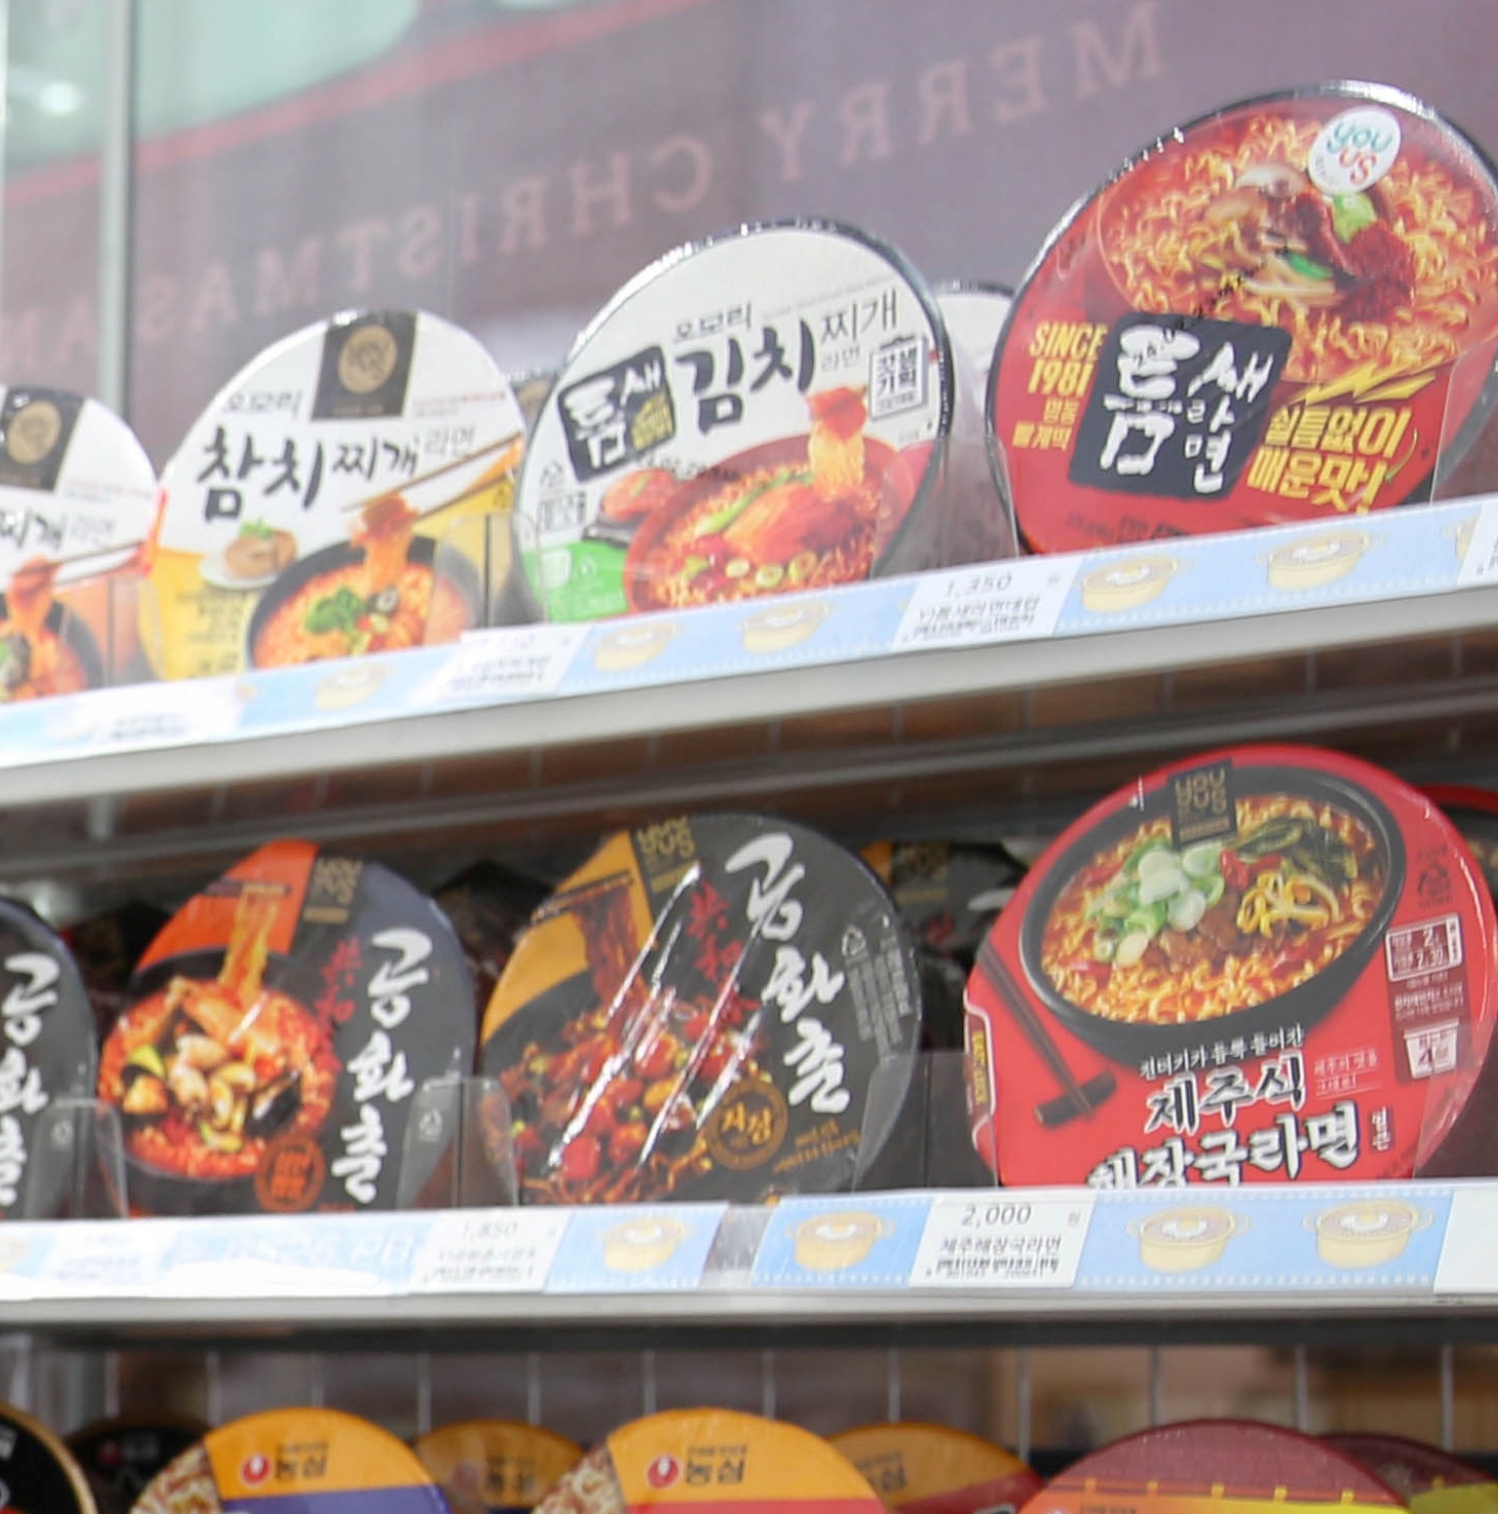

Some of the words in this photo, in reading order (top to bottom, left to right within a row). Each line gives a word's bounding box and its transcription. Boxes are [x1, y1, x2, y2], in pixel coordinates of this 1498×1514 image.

[820, 288, 897, 344] 찌개
[1029, 322, 1108, 360] SINCE
[675, 319, 816, 435] 김치
[1027, 360, 1095, 397] 1981
[198, 424, 420, 522] 참치찌개
[1144, 1051, 1306, 1135] 제주식
[962, 1204, 1032, 1227] 2,000
